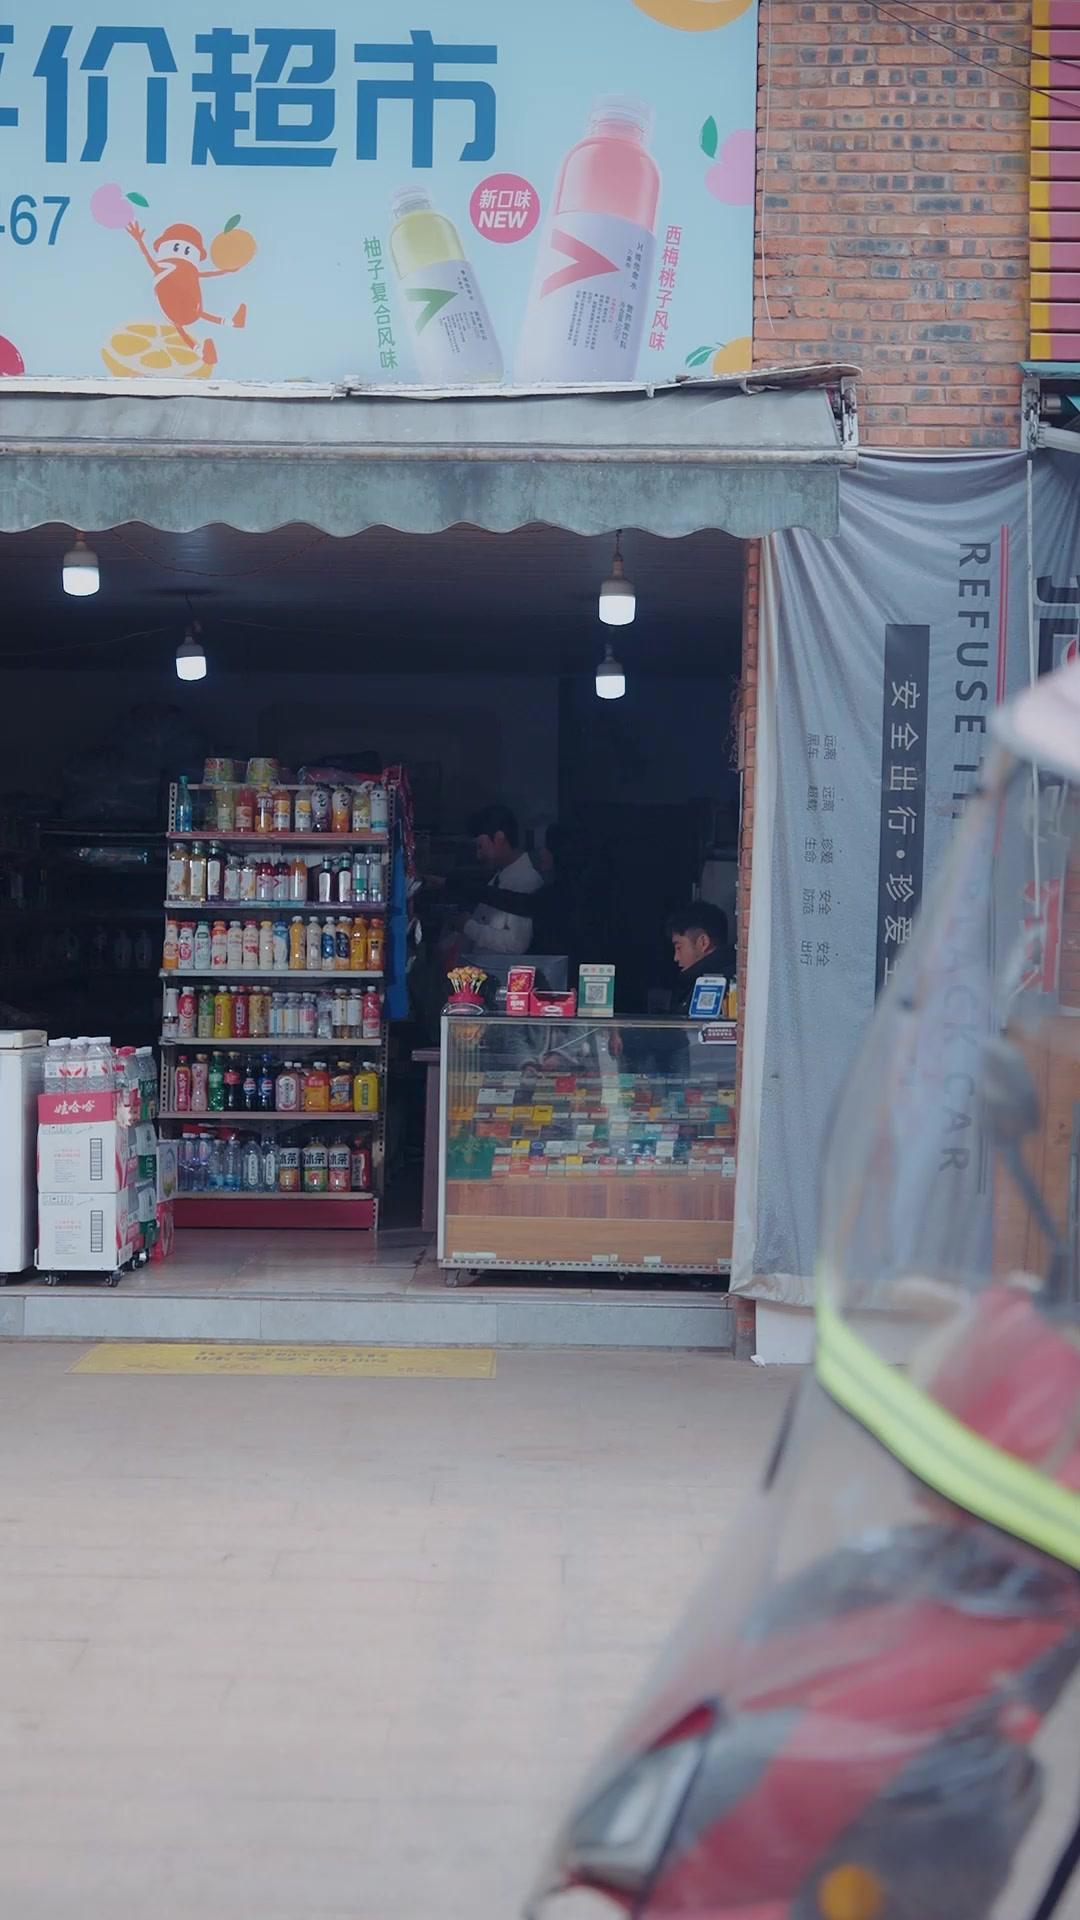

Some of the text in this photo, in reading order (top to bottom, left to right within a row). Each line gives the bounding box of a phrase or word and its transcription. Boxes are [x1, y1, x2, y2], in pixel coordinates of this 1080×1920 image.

[0, 25, 498, 168] 价超市
[0, 194, 70, 246] 67
[478, 188, 532, 210] 新口味
[478, 210, 529, 229] NEW
[362, 236, 399, 370] 柚子复合风味
[648, 225, 683, 352] 西梅桃子风味
[955, 542, 991, 734] REFUSE
[54, 1100, 95, 1115] 娃哈哈
